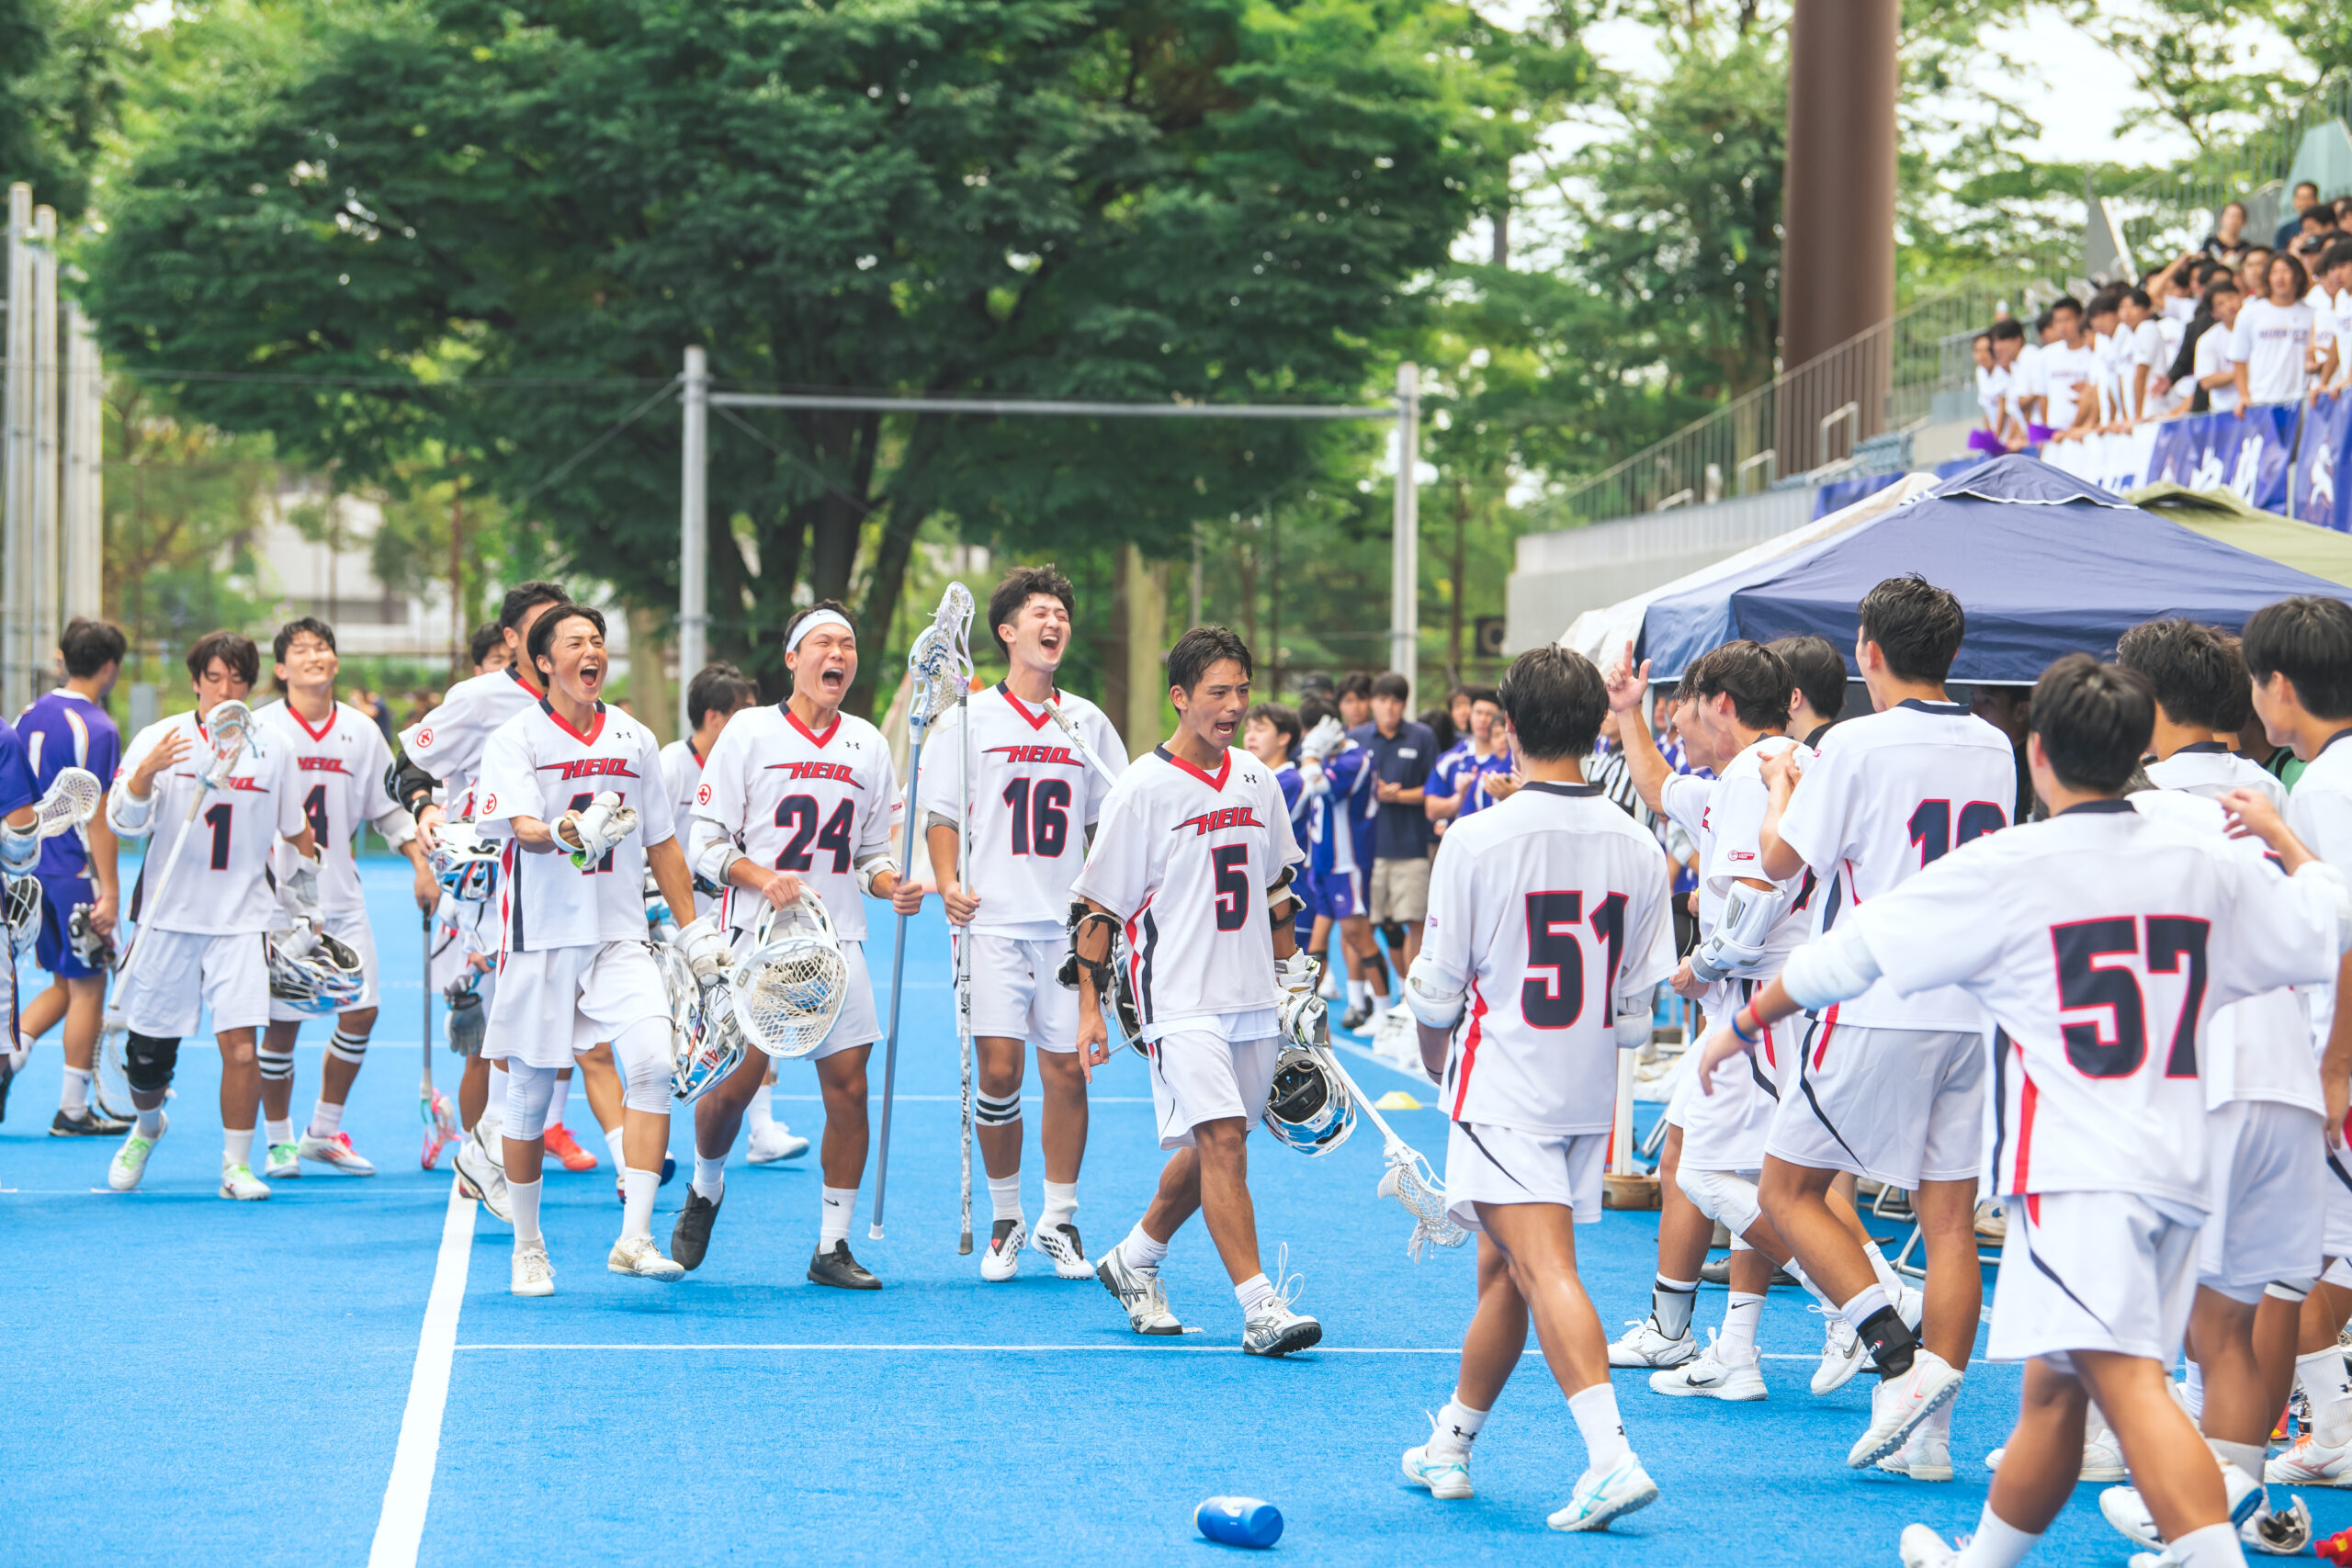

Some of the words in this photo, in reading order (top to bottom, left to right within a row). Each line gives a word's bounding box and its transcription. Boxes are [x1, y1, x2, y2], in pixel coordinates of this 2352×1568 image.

[536, 758, 640, 781] KEIO
[763, 761, 865, 790] KEIO
[982, 745, 1085, 768] KEIO
[204, 802, 233, 872] 1
[301, 784, 328, 849] 4
[775, 794, 855, 874] 24
[1002, 777, 1072, 859] 16
[1171, 807, 1265, 836] KEIO
[1211, 842, 1250, 932] 5
[1521, 890, 1630, 1030] 51
[2050, 914, 2211, 1079] 57
